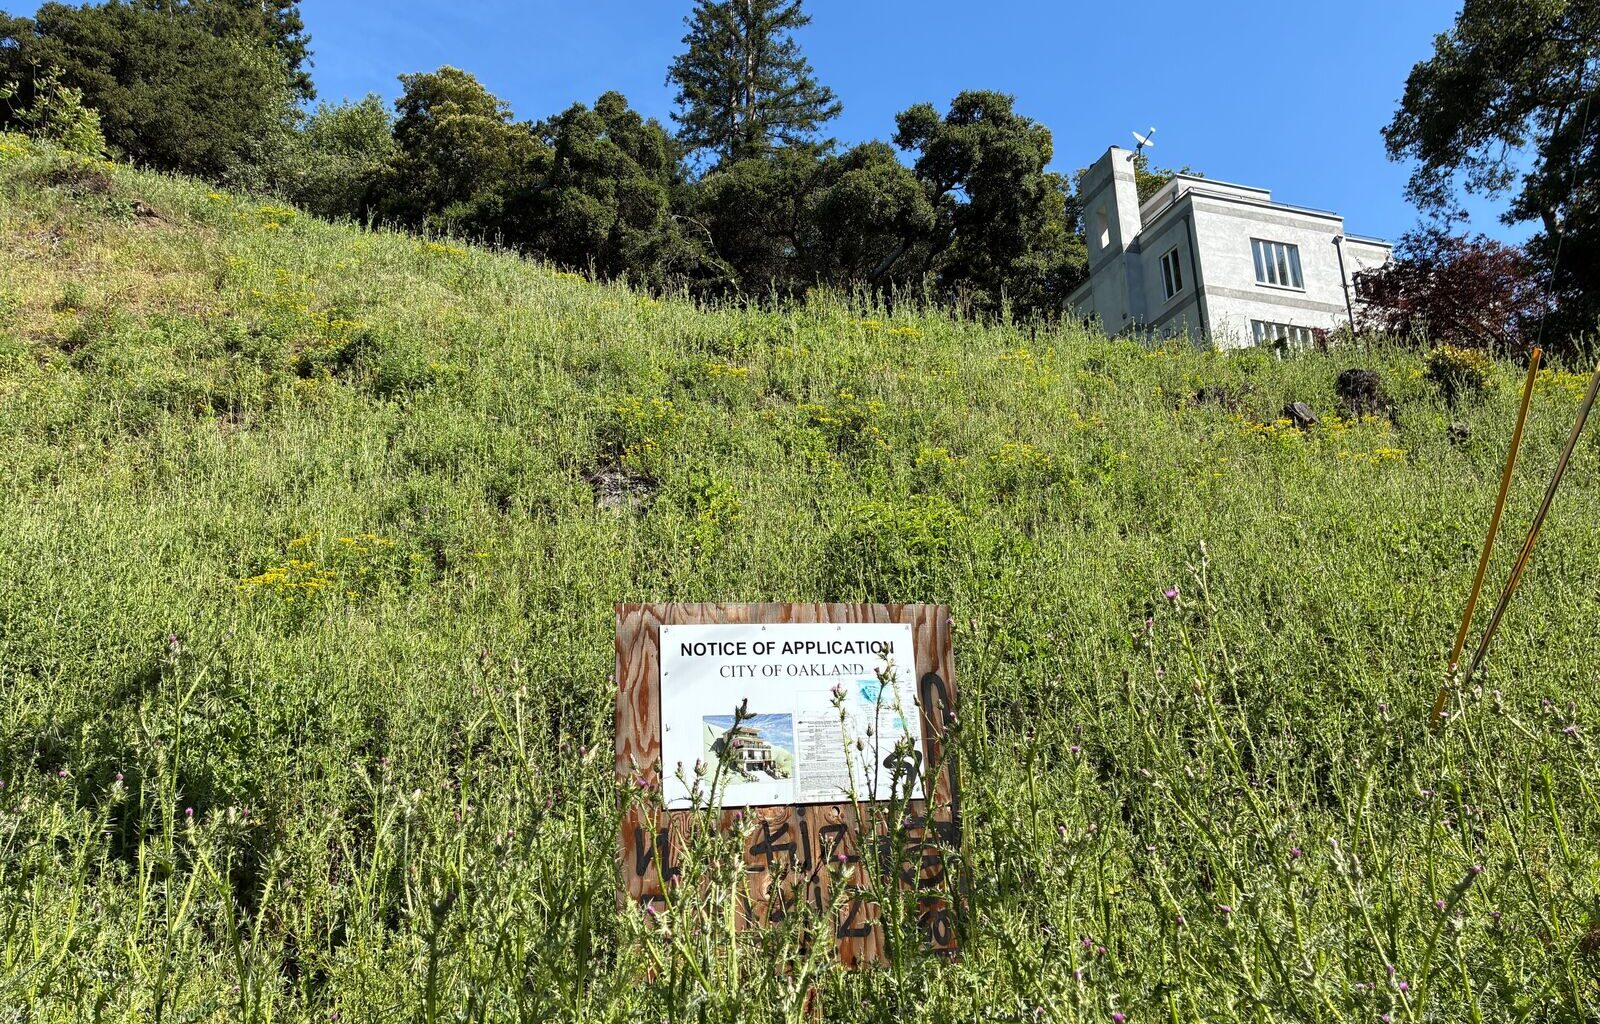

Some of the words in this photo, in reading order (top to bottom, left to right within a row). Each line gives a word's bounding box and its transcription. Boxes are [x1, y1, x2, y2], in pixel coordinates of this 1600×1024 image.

[681, 642, 747, 656] NOTICE
[752, 641, 776, 655] OF
[719, 664, 757, 678] CITY
[762, 663, 783, 677] OF
[786, 663, 864, 677] OAKLAND
